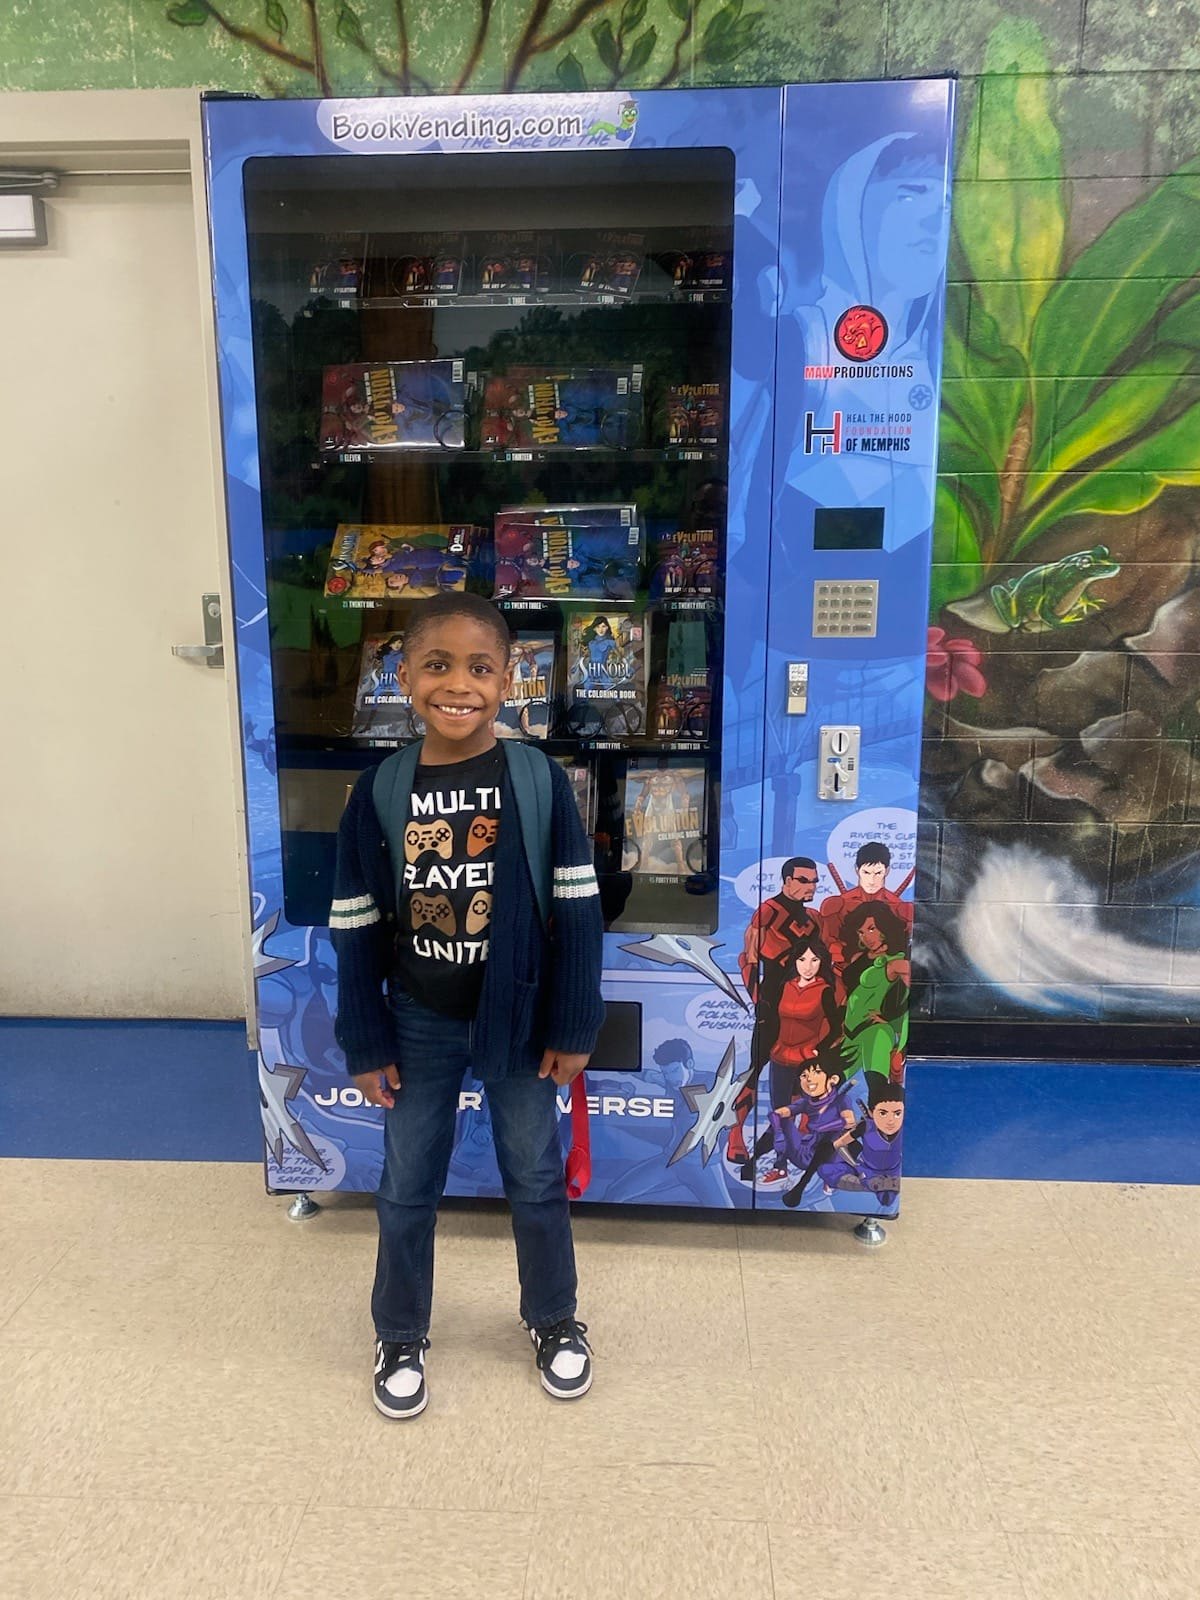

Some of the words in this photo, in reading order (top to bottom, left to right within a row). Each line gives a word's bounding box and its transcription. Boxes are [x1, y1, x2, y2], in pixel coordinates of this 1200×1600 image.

[331, 111, 583, 144] BookVending.com
[804, 365, 914, 379] MAWPRODUCTIONS
[846, 413, 866, 423] HEAL
[870, 413, 884, 423] THE
[888, 412, 912, 423] HOOD
[845, 425, 912, 436] FOUNDATION
[845, 438, 858, 452] OF
[861, 437, 911, 452] MEMPHIS
[576, 689, 587, 698] THE
[588, 689, 618, 699] COLORING
[619, 690, 637, 699] BOOK
[365, 696, 376, 704] THE
[377, 696, 407, 704] COLORING
[410, 786, 502, 817] MULTI
[877, 822, 897, 830] THE
[850, 831, 891, 840] RIVER'S
[269, 1166, 316, 1175] PEOPLE
